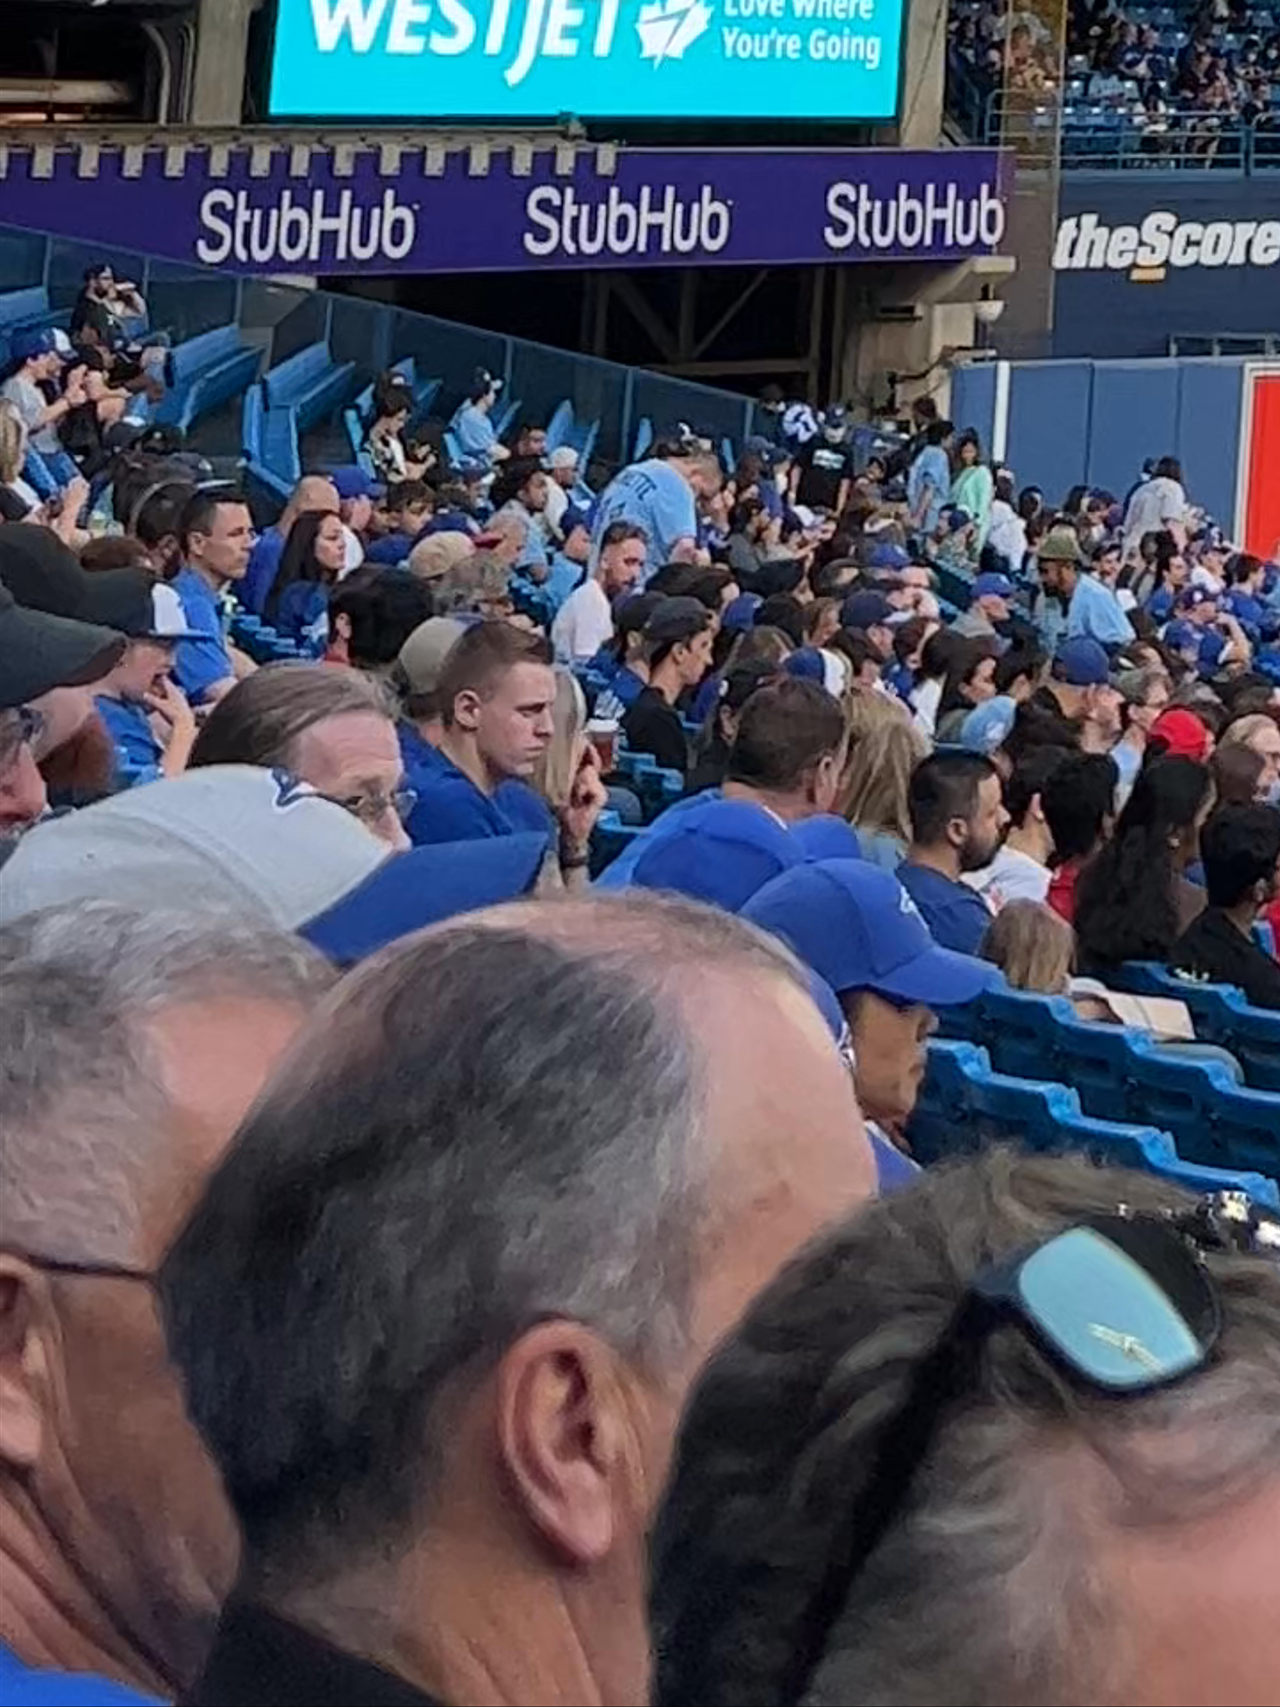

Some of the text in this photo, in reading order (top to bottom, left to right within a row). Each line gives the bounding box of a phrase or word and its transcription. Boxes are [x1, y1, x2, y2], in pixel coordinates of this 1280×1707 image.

[722, 27, 881, 70] You're Going
[197, 189, 415, 263] StubHub
[523, 185, 731, 255] StubHub
[823, 182, 1004, 249] StubHub
